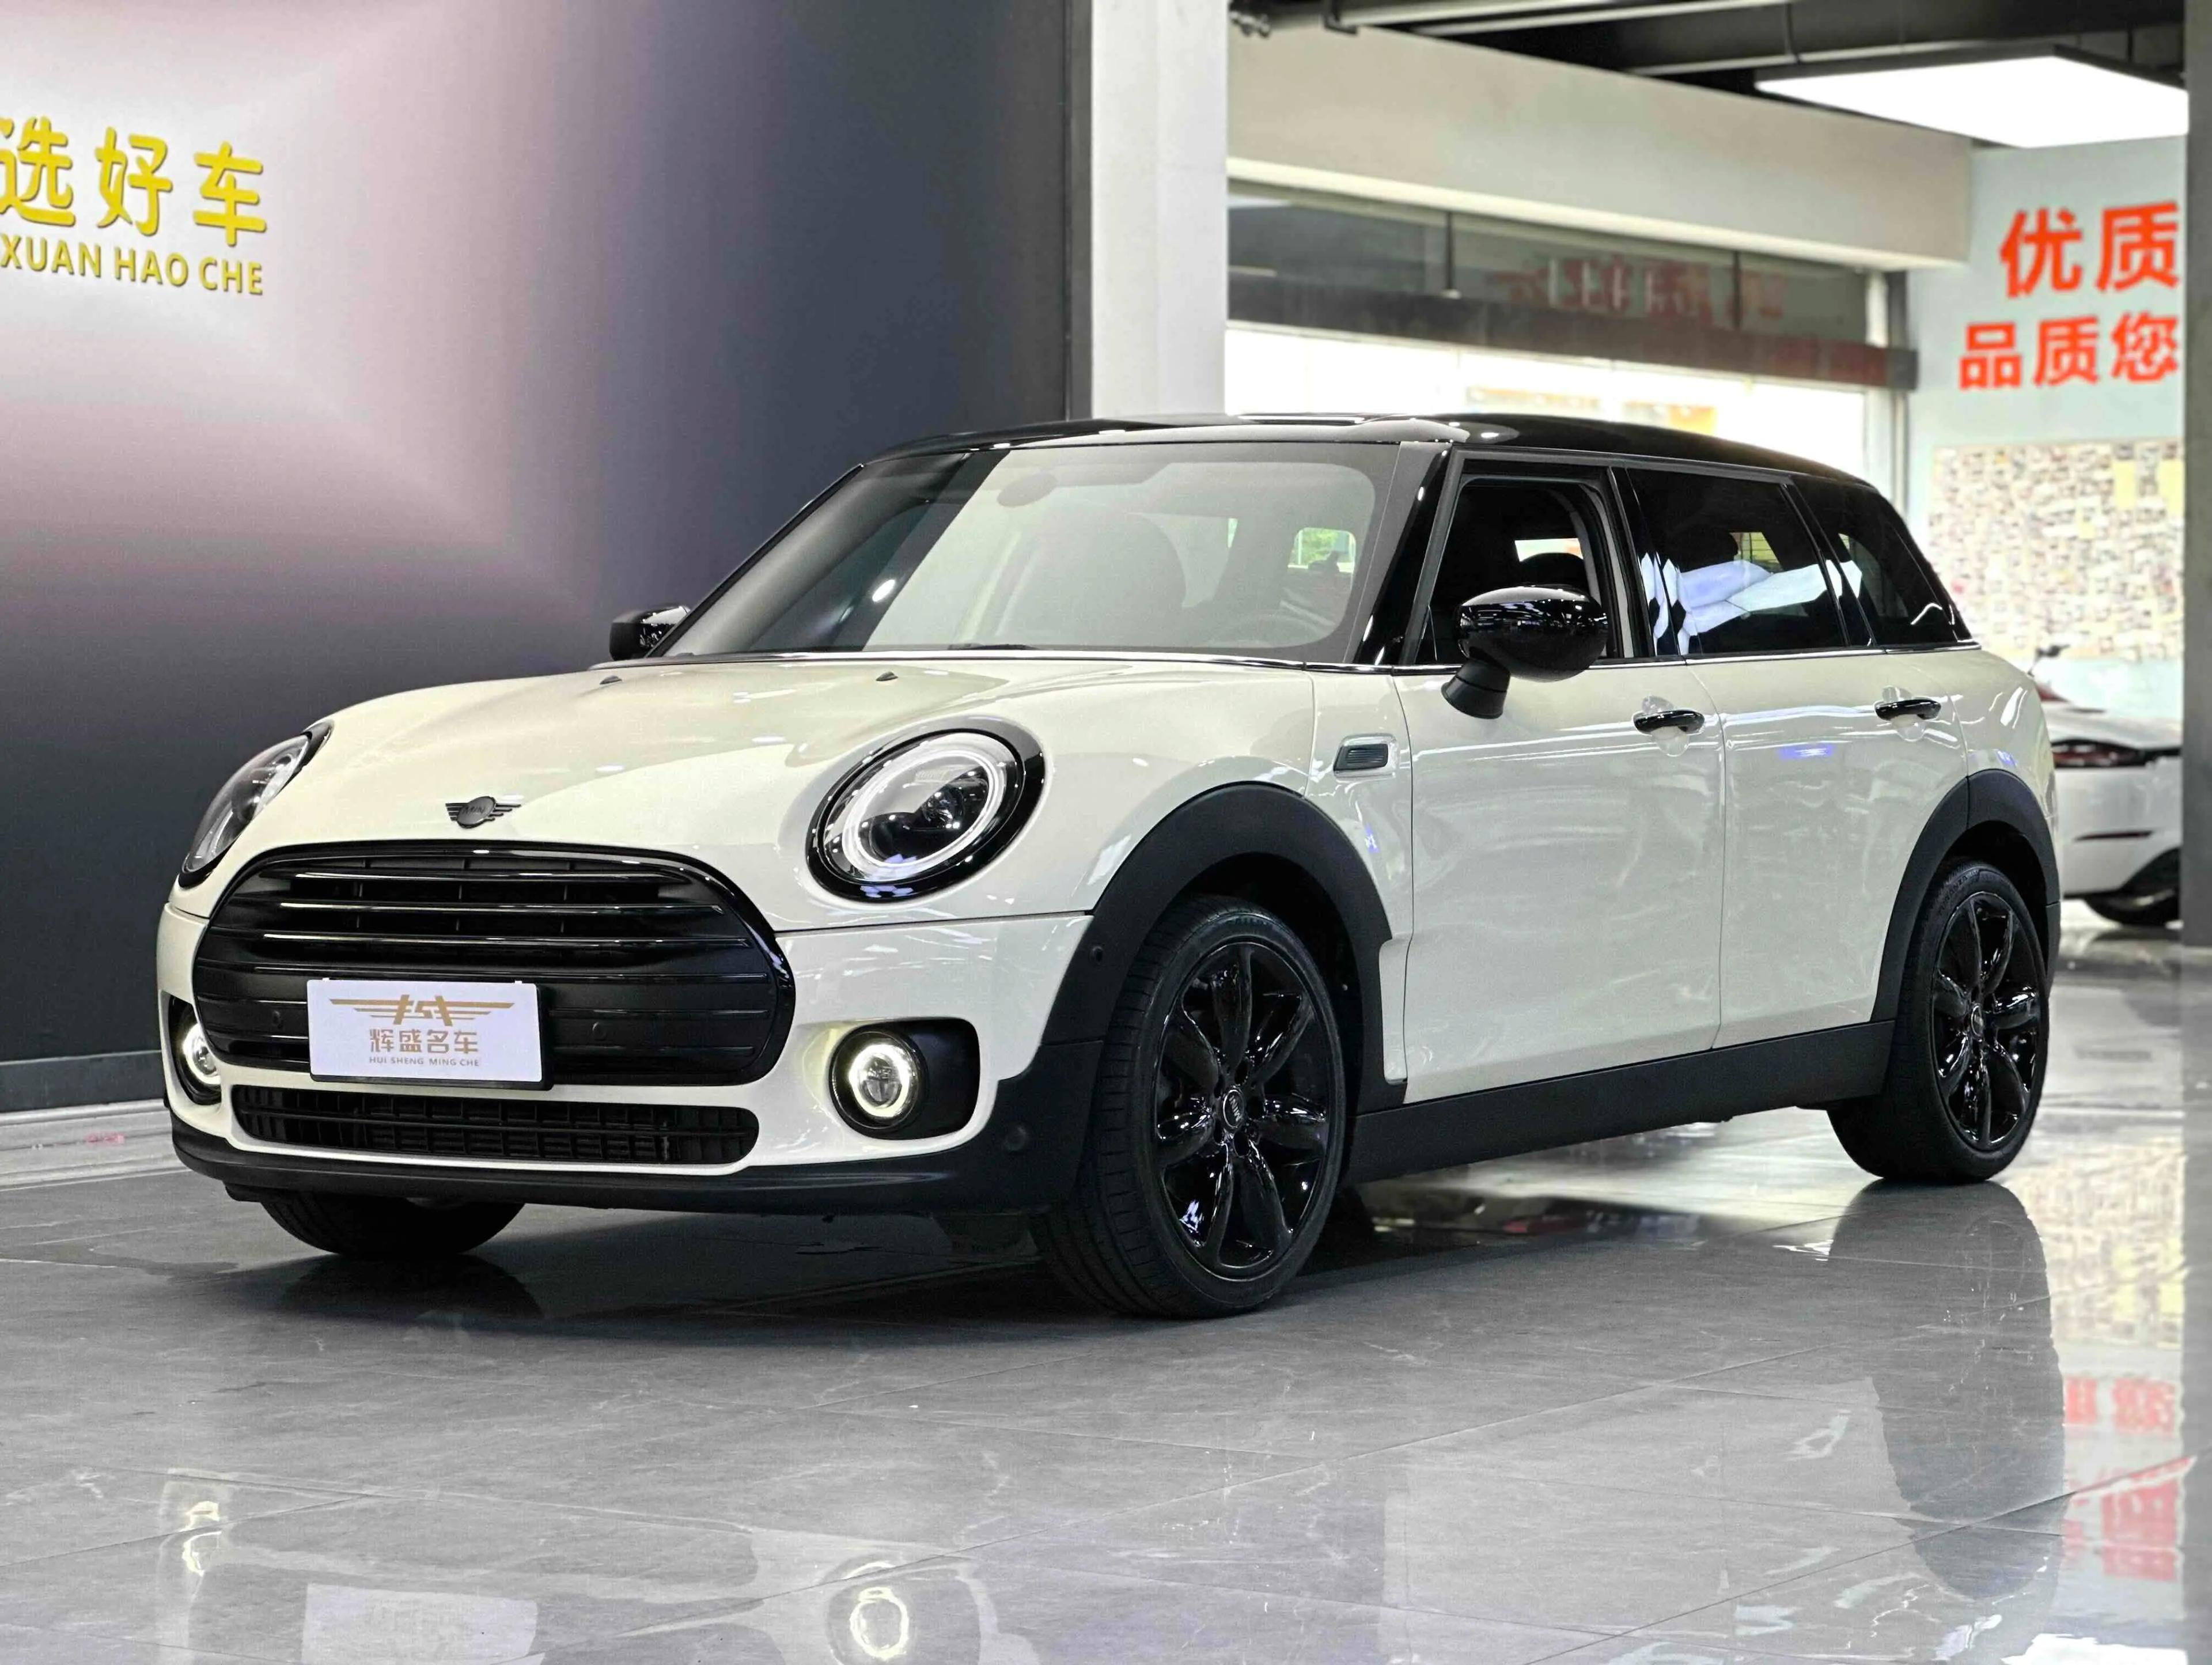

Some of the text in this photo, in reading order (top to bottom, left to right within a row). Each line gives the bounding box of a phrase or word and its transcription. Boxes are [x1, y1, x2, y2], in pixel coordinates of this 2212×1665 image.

[0, 115, 267, 247] 选好车
[0, 234, 263, 296] XUAN HAO CHE
[1998, 201, 2179, 298] 优质
[1959, 311, 2179, 391] 品质您
[369, 1056, 387, 1064] HUI
[391, 1057, 424, 1065] SHENG
[459, 1059, 479, 1067] CHE
[370, 1028, 479, 1054] 辉盛名车
